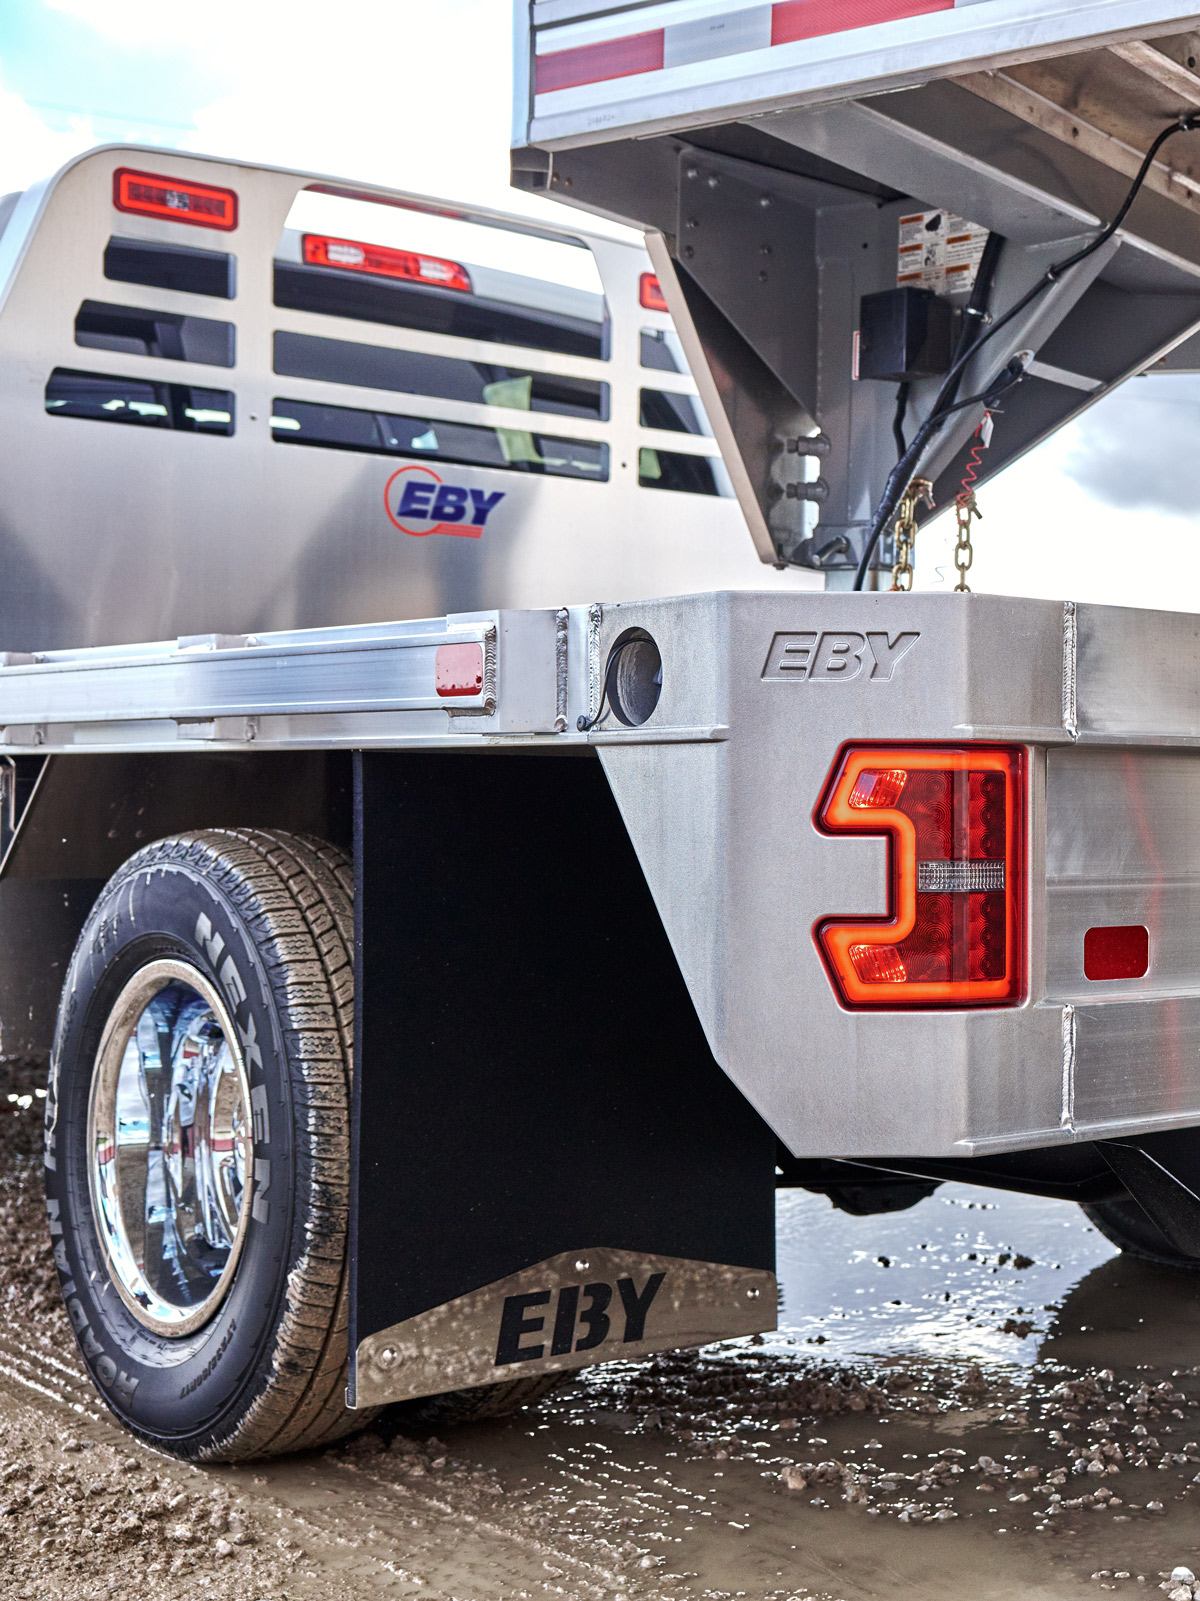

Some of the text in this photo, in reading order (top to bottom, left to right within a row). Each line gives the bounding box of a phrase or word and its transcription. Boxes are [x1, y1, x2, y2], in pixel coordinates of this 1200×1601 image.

[397, 481, 506, 526] EBY
[760, 631, 922, 682] EBY
[195, 911, 271, 1225] NEXEN
[46, 1199, 140, 1407] ROADIAN
[494, 1271, 667, 1367] EBY
